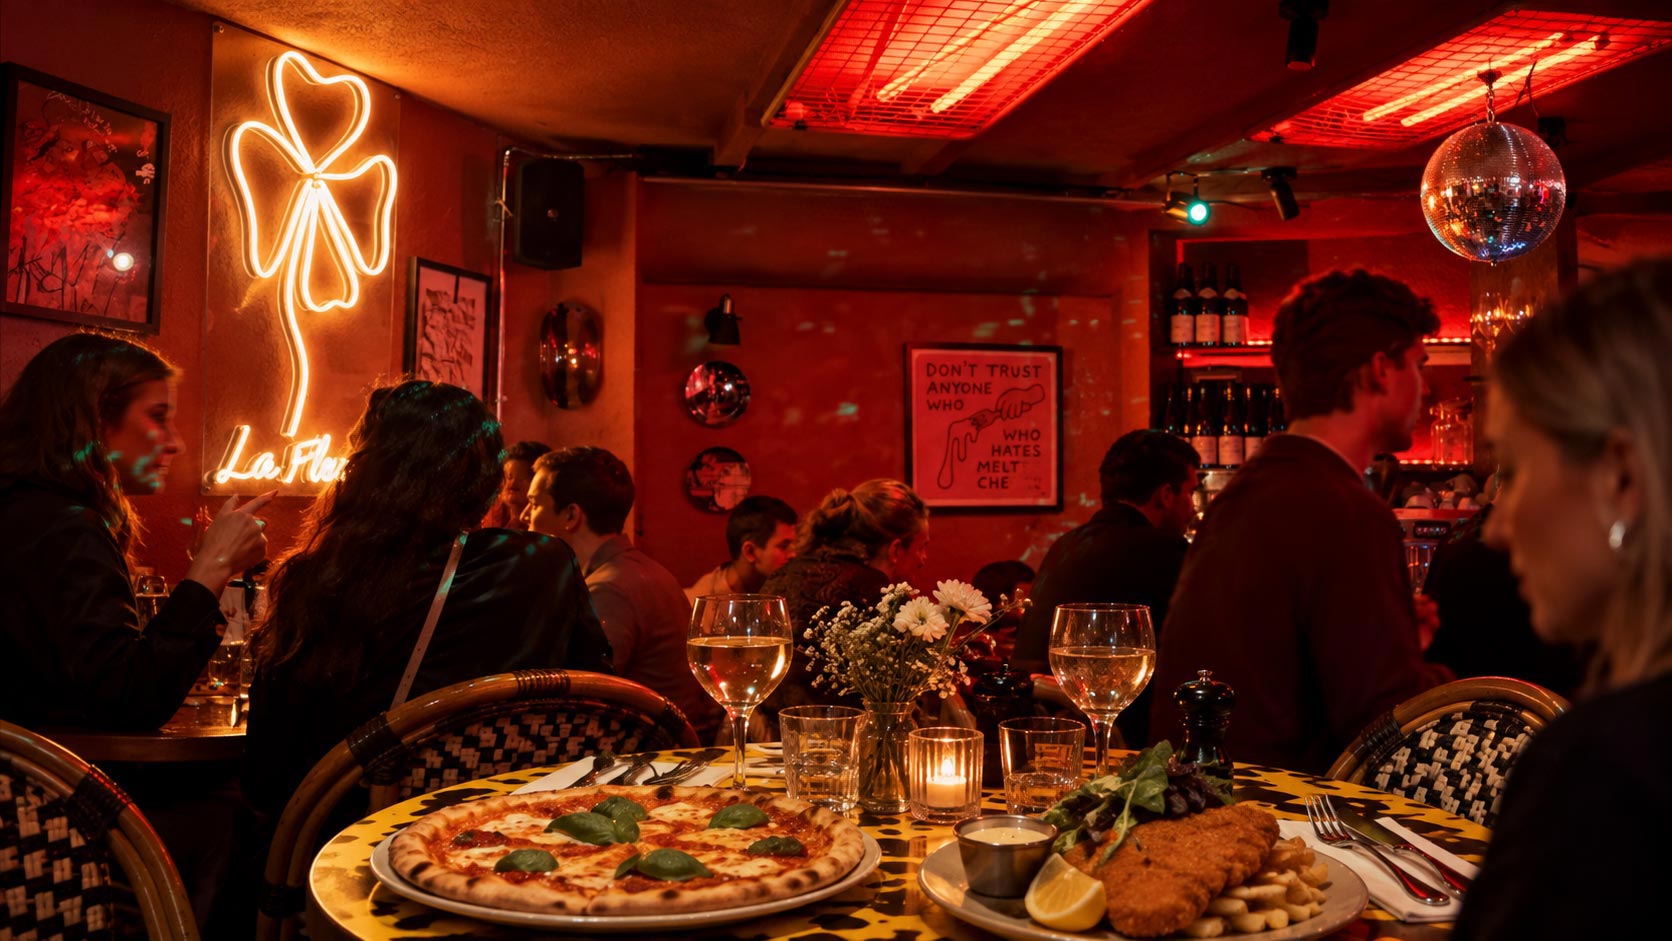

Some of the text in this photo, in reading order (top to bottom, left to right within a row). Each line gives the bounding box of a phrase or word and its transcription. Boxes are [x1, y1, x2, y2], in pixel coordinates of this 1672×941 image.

[926, 361, 1042, 378] DON'T TRUST
[926, 381, 993, 395] ANYONE
[926, 399, 965, 411] WHO
[1002, 428, 1041, 441] WHO
[216, 424, 281, 484] La
[991, 444, 1041, 458] HATES
[976, 460, 1020, 473] MELT
[977, 476, 1009, 489] CHE
